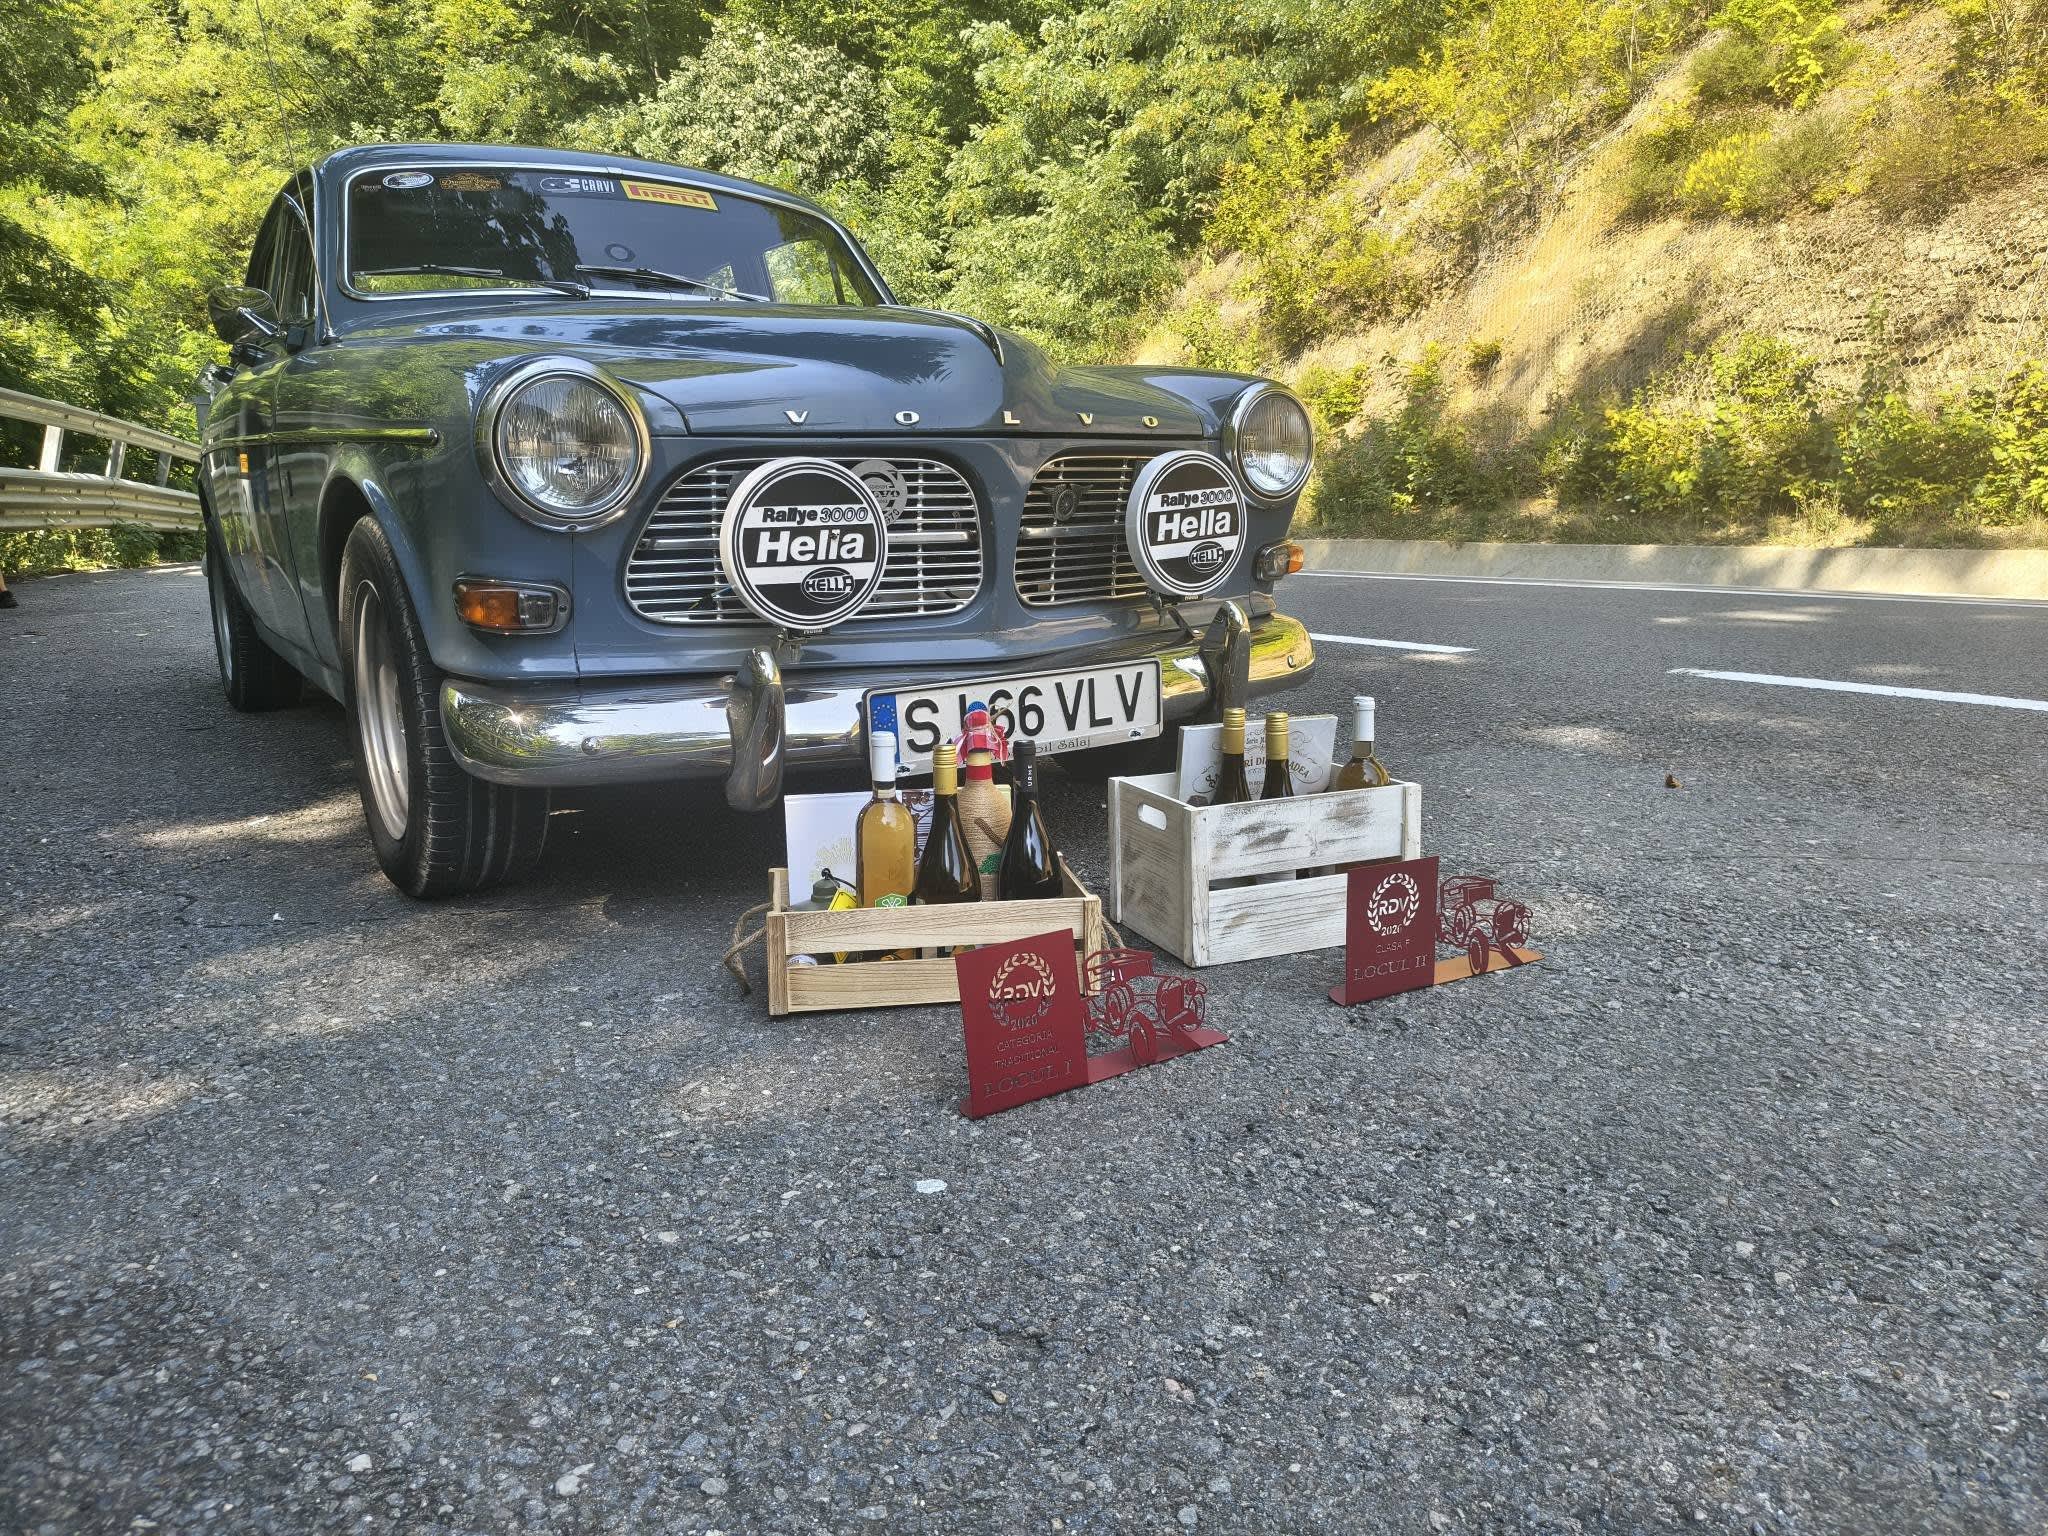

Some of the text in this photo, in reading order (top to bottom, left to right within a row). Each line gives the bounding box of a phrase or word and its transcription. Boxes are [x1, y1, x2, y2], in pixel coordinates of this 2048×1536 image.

[581, 179, 615, 193] CARVI
[628, 184, 710, 206] PIRELLI
[784, 410, 1159, 428] VOLVO
[1160, 488, 1233, 509] Rallye 3000
[762, 507, 818, 525] Rallye
[819, 507, 868, 522] 3000
[1157, 508, 1231, 542] Hella
[756, 528, 864, 563] Hella
[1191, 547, 1225, 563] HELLA
[804, 575, 854, 592] HELLA
[988, 686, 1045, 739] 66
[1055, 671, 1143, 731] VLV
[1378, 896, 1410, 916] RDV
[1353, 959, 1411, 981] LOCUL
[1003, 979, 1042, 1003] RDV
[996, 1030, 1053, 1052] CATEGORIA
[984, 1065, 1059, 1098] LOCUL
